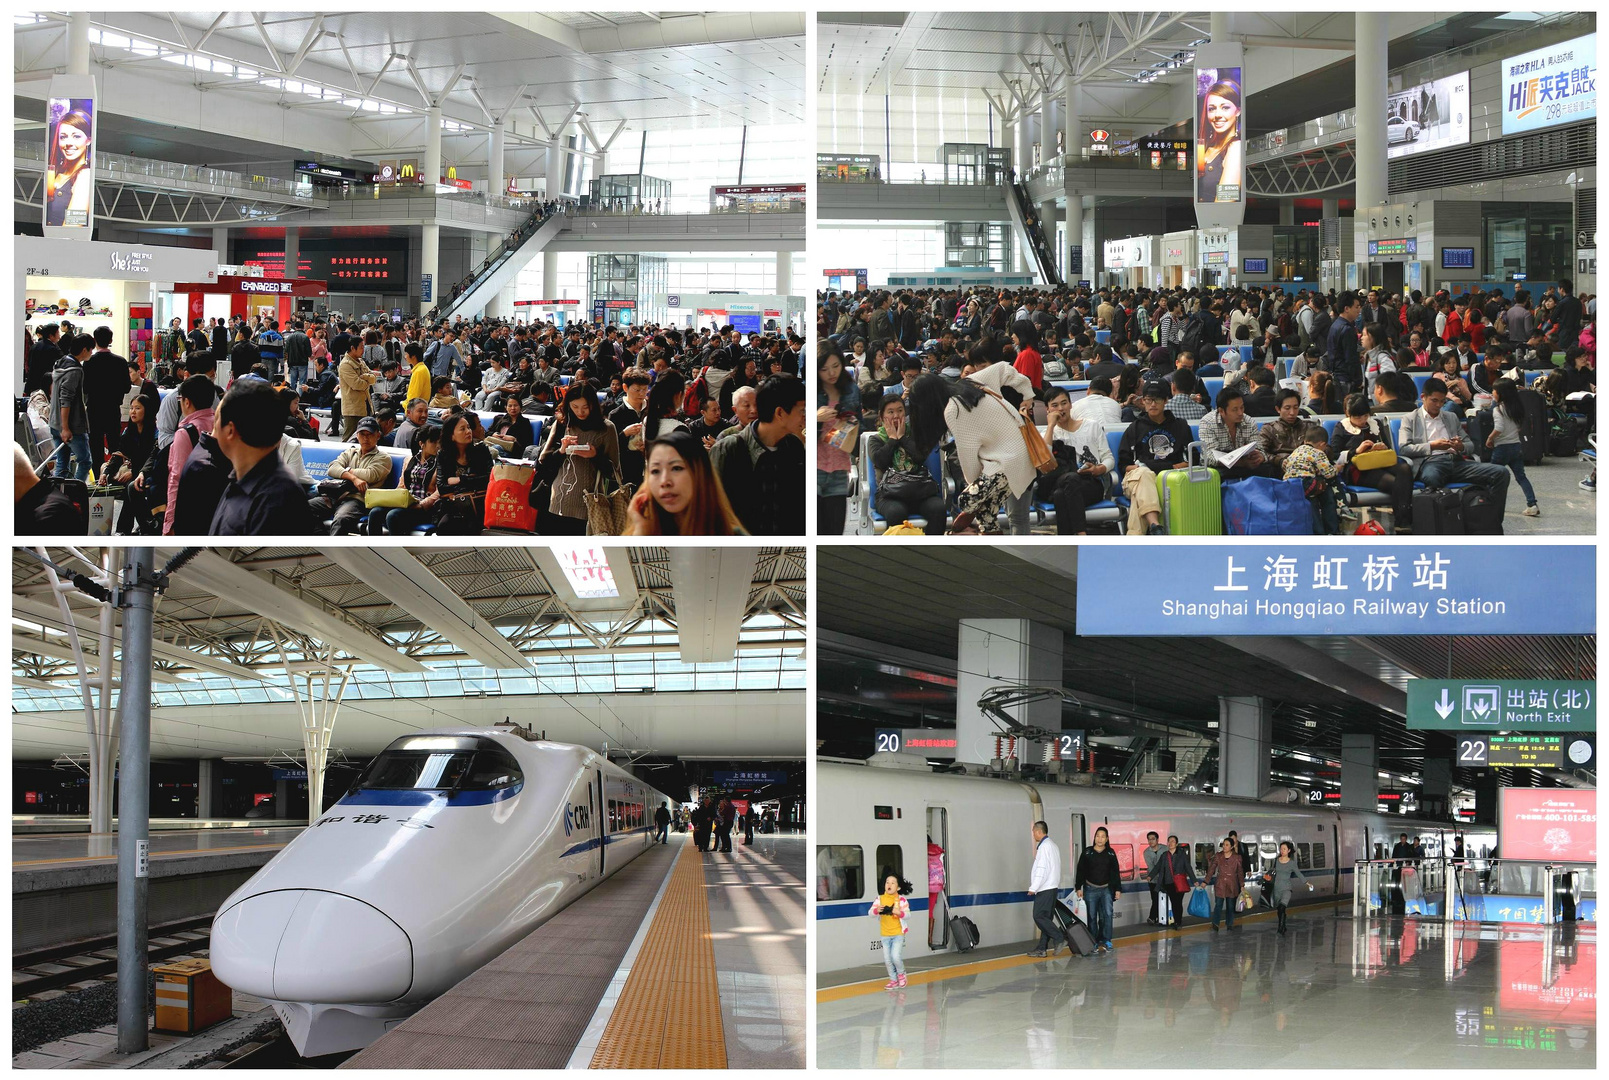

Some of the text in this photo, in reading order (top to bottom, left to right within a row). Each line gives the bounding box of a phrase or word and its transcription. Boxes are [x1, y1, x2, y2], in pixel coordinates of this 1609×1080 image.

[1571, 79, 1596, 96] JACK
[110, 251, 131, 271] She's
[26, 267, 49, 276] 2F-43
[1213, 552, 1451, 592] 上海虹桥站
[1161, 598, 1507, 618] Shanghai Hongqiao Railway Station
[1506, 712, 1571, 723] North Exit
[878, 734, 899, 752] 20
[905, 739, 957, 748] 上海虹桥站欢迎
[1060, 736, 1081, 754] 21
[1460, 740, 1485, 761] 22
[1311, 791, 1322, 801] 20
[1403, 792, 1414, 802] 21
[574, 805, 590, 830] CRH
